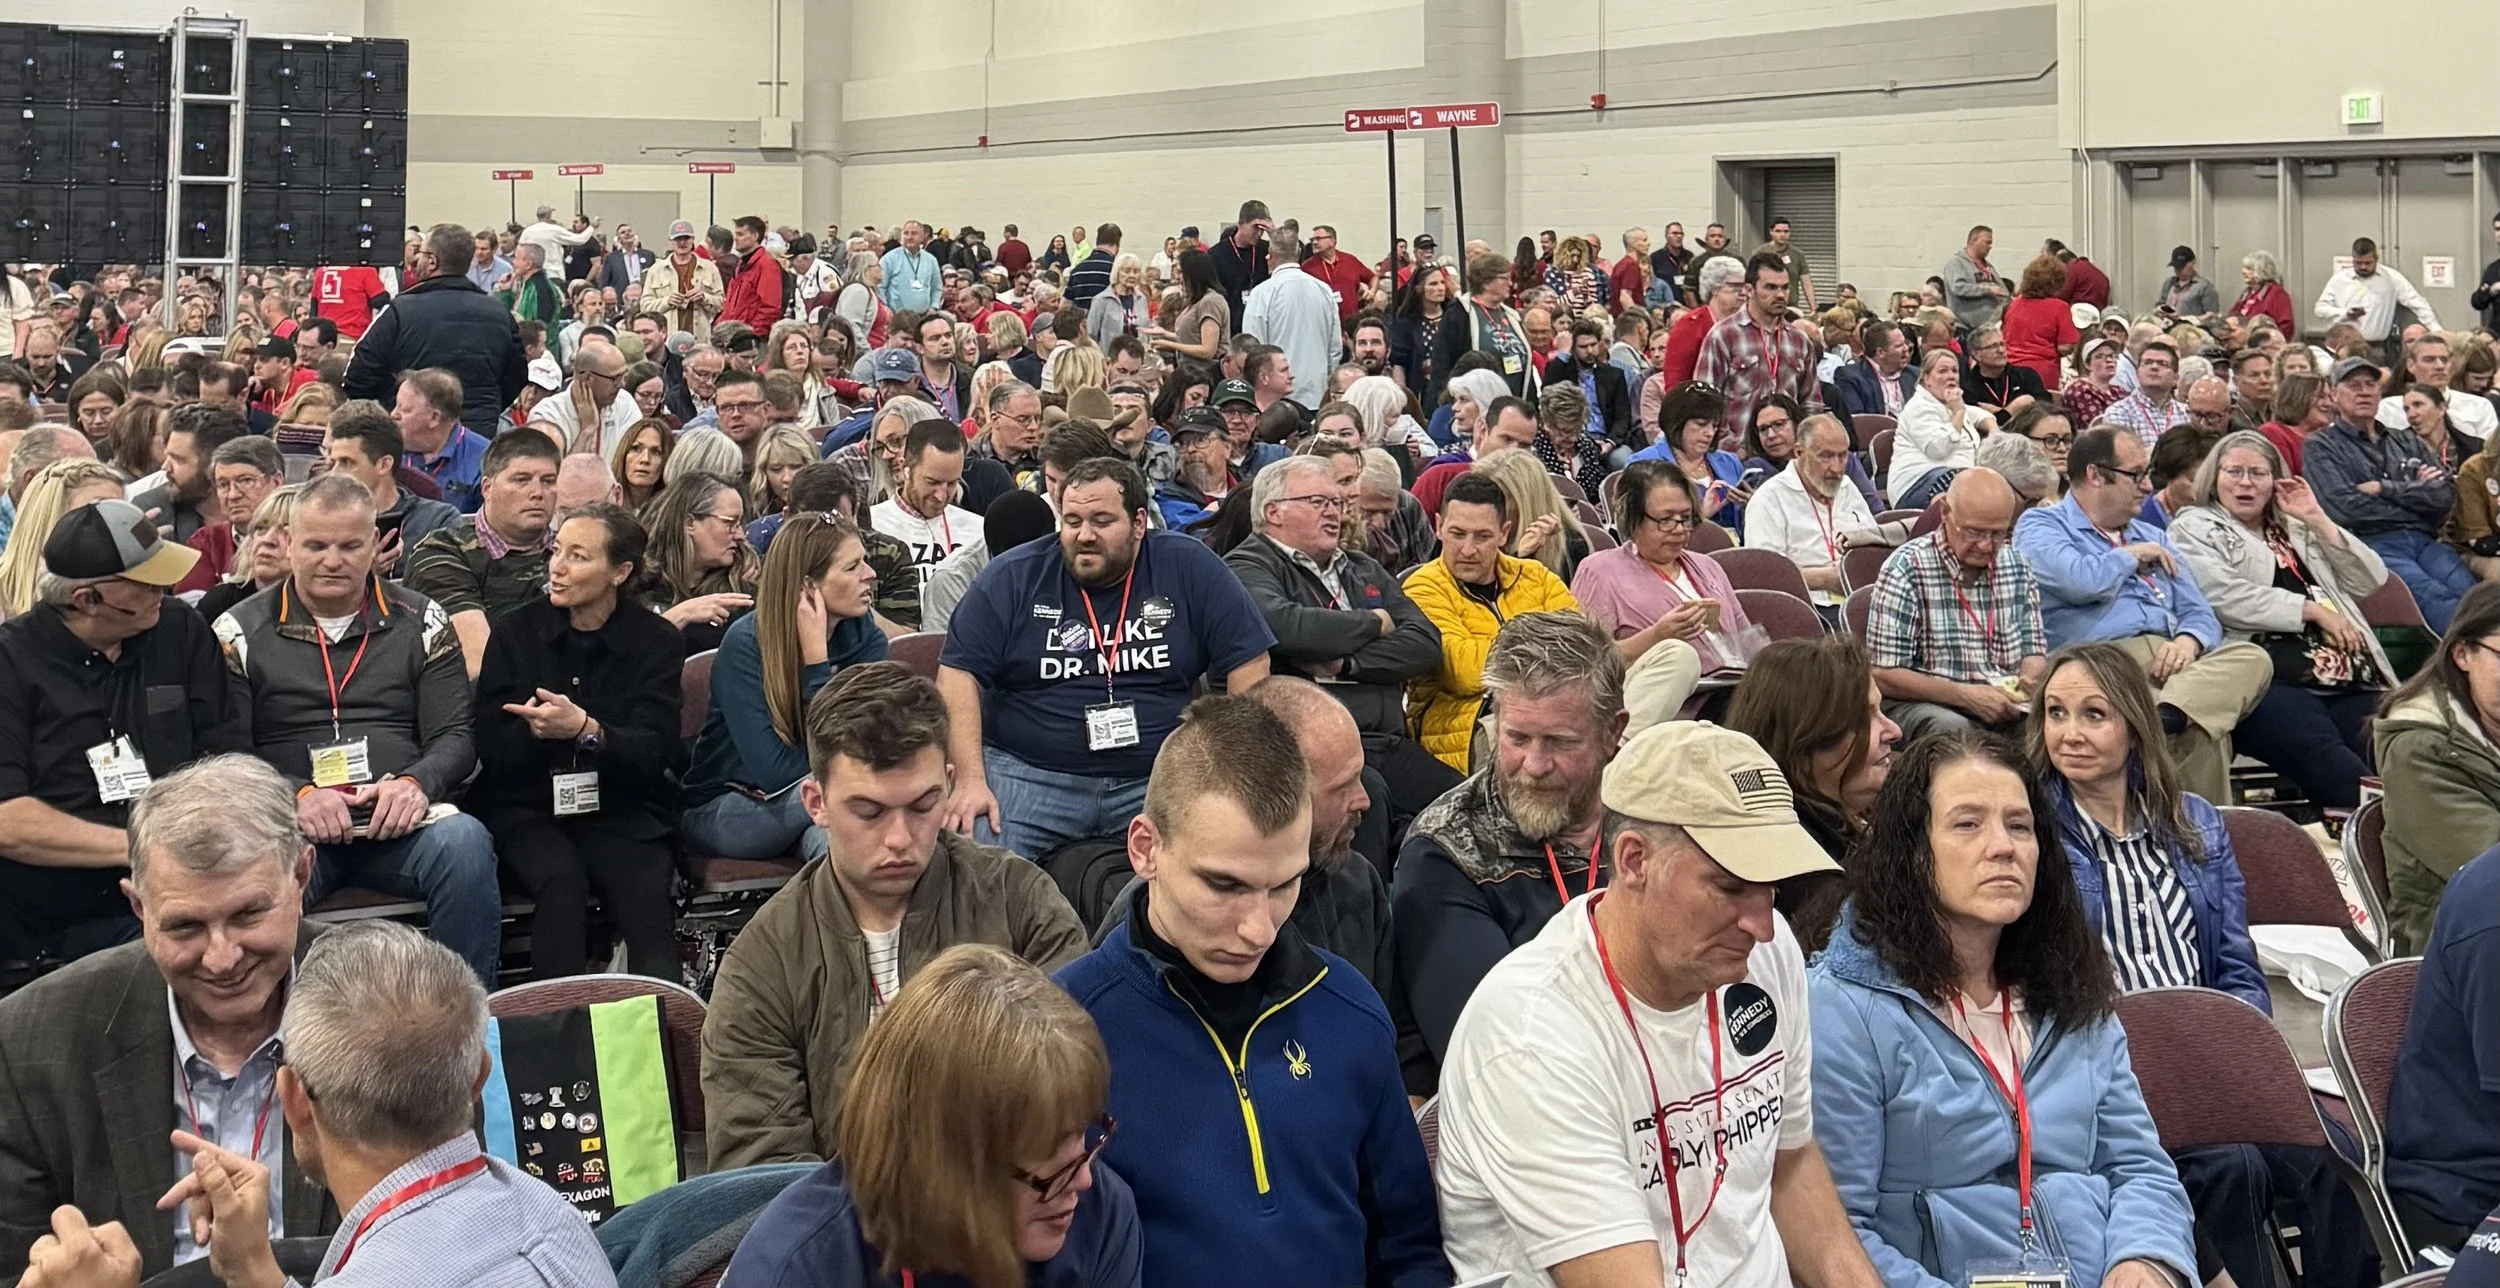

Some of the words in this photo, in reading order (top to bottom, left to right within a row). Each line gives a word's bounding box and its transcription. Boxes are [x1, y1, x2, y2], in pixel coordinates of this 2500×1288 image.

[1436, 110, 1477, 122] WAYNE
[2349, 98, 2371, 119] EXIT
[1040, 657, 1090, 679] DR.
[1097, 645, 1171, 674] MIKE
[1730, 996, 1769, 1037] KENNEDY
